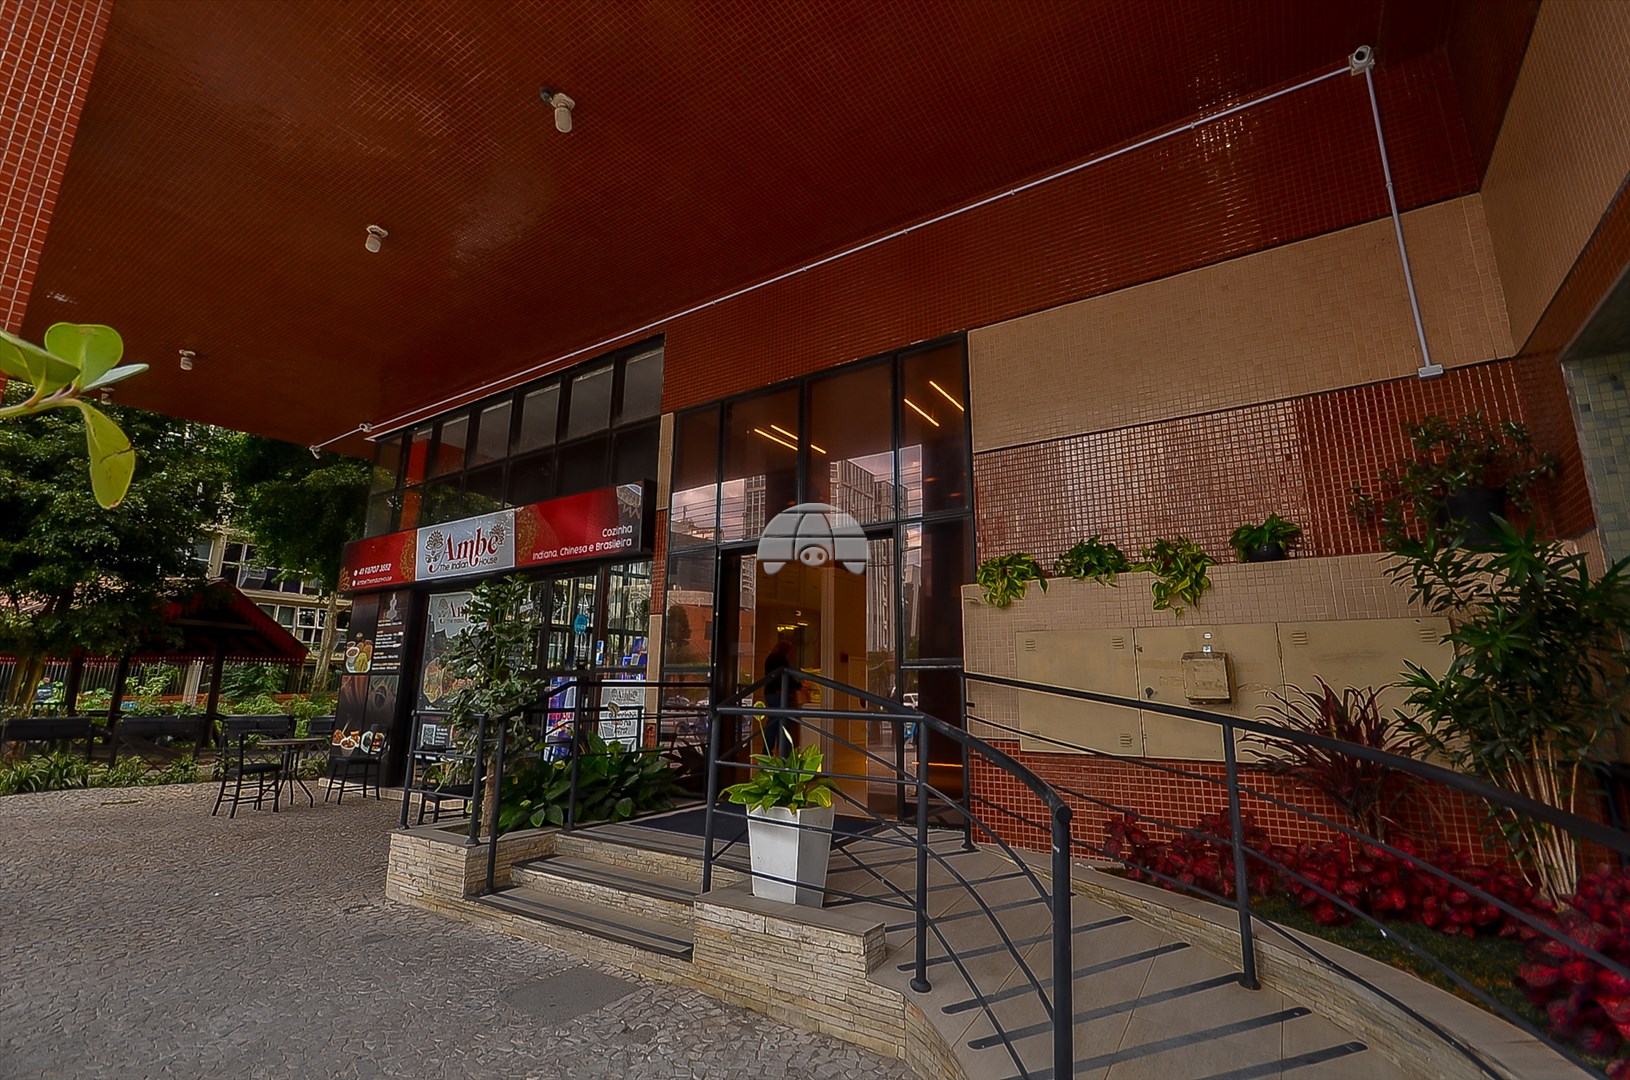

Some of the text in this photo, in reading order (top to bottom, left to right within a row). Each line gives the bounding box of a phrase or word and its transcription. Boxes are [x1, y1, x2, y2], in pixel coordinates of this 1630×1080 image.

[602, 525, 632, 537] Cozinha
[429, 527, 499, 574] Ambe
[532, 538, 632, 560] Indiana, Chinesa e Brasileira
[440, 556, 498, 571] The Indian House
